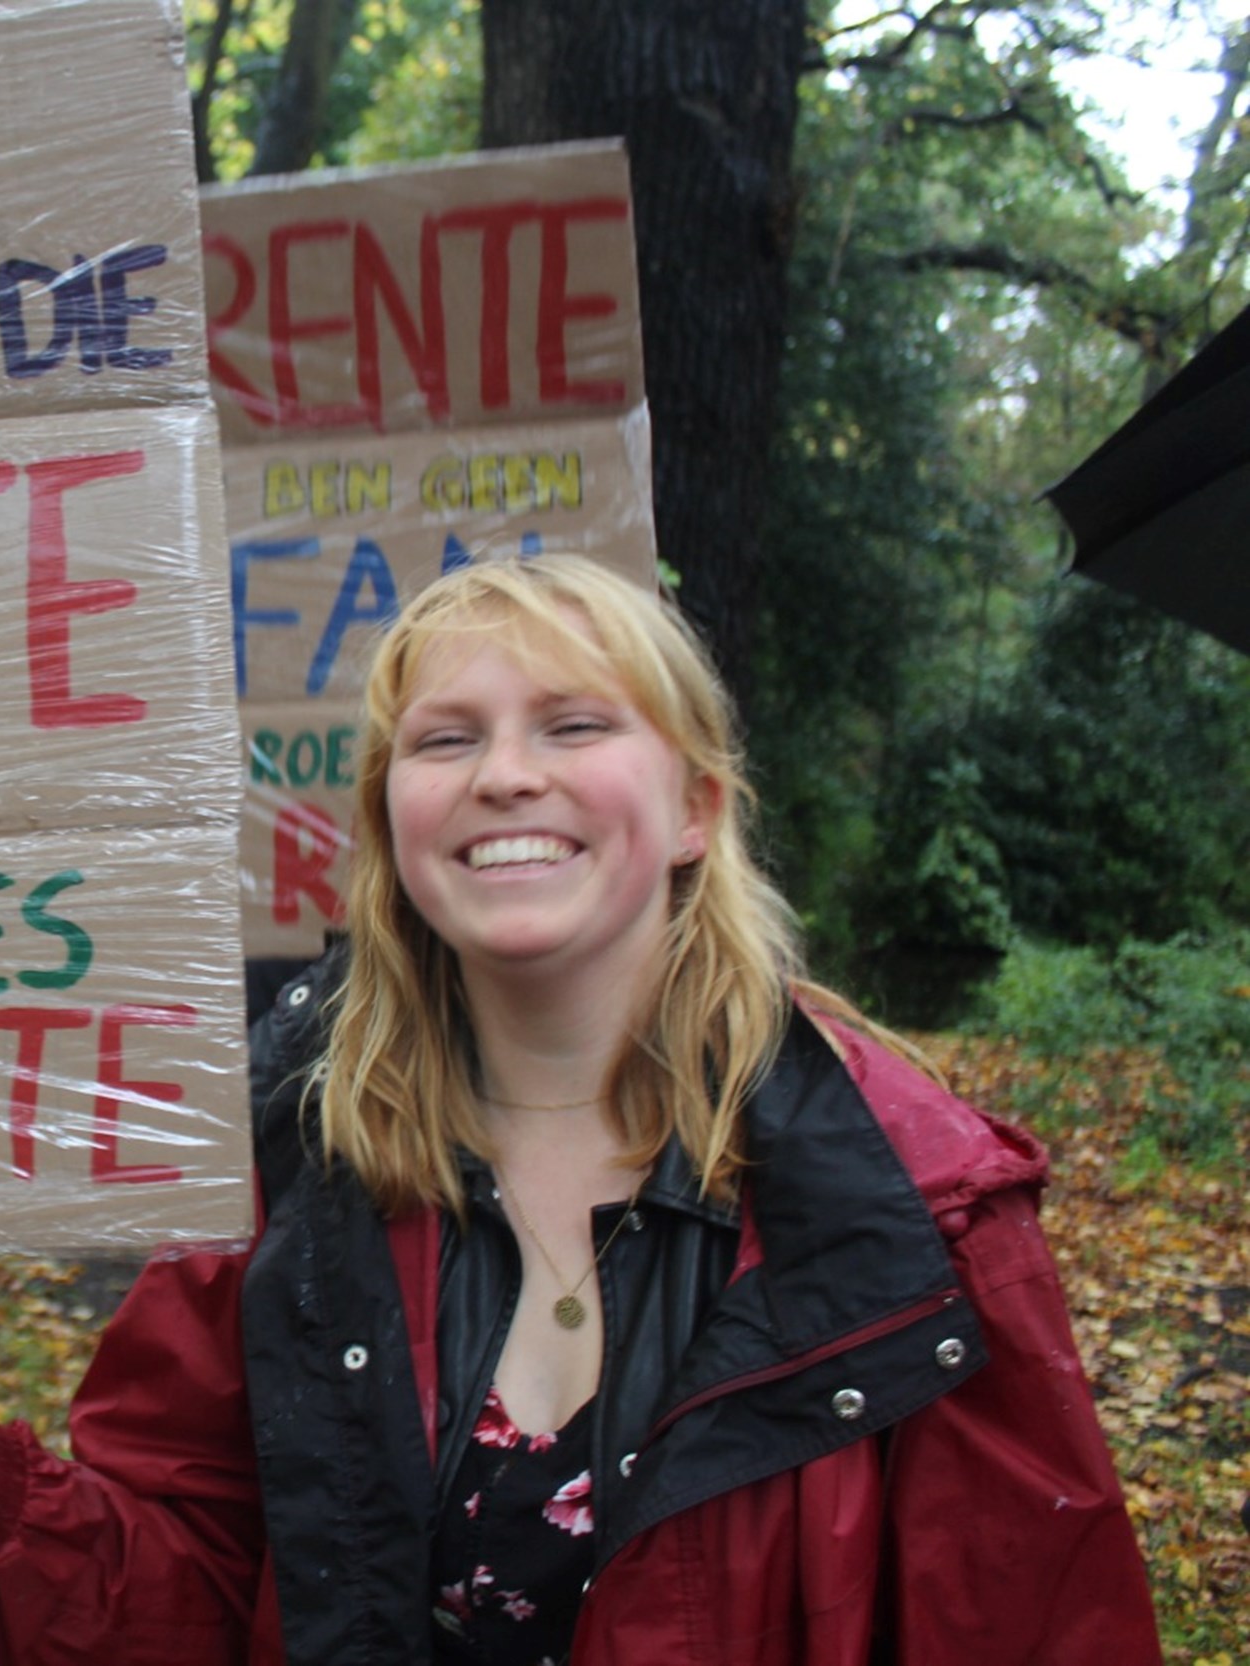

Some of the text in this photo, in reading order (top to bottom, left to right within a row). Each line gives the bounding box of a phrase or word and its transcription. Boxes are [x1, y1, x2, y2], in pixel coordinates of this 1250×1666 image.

[264, 449, 583, 519] BEN GEEN
[230, 531, 544, 696] FA
